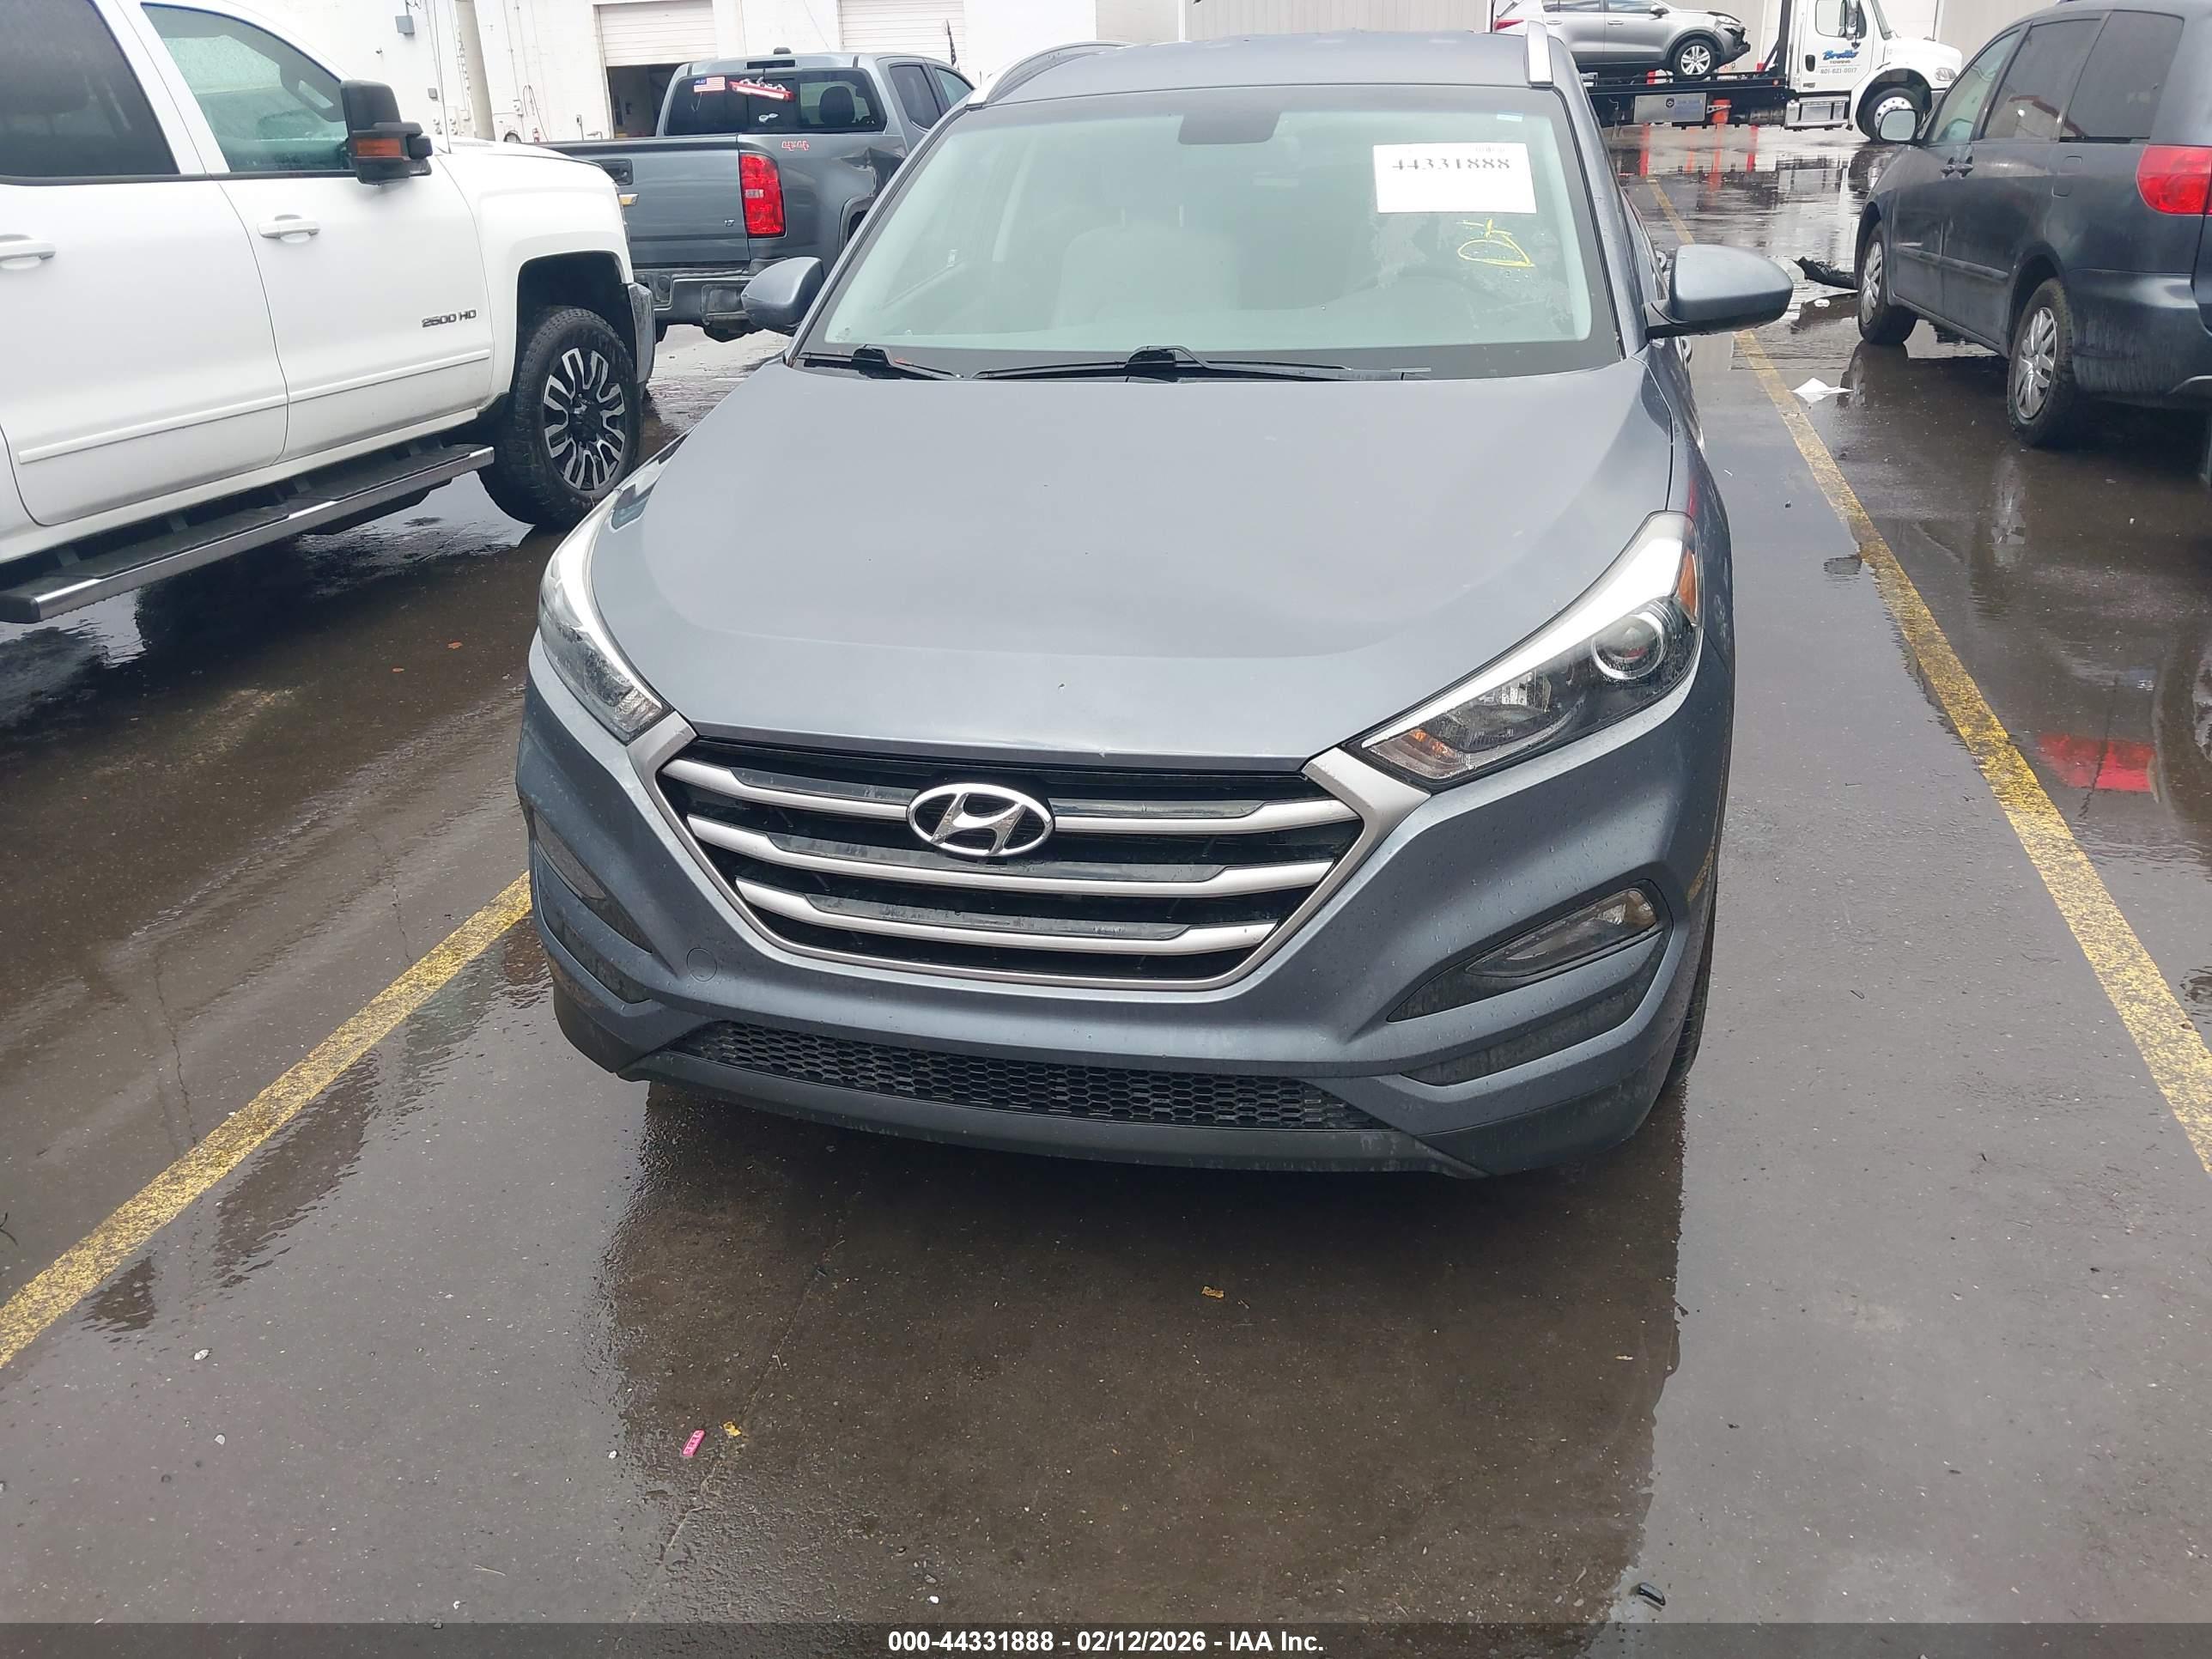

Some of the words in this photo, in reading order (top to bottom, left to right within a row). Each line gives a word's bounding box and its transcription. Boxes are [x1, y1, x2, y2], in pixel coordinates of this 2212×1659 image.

[1392, 157, 1510, 170] 44331888
[421, 313, 457, 328] 2500
[459, 308, 477, 321] HD
